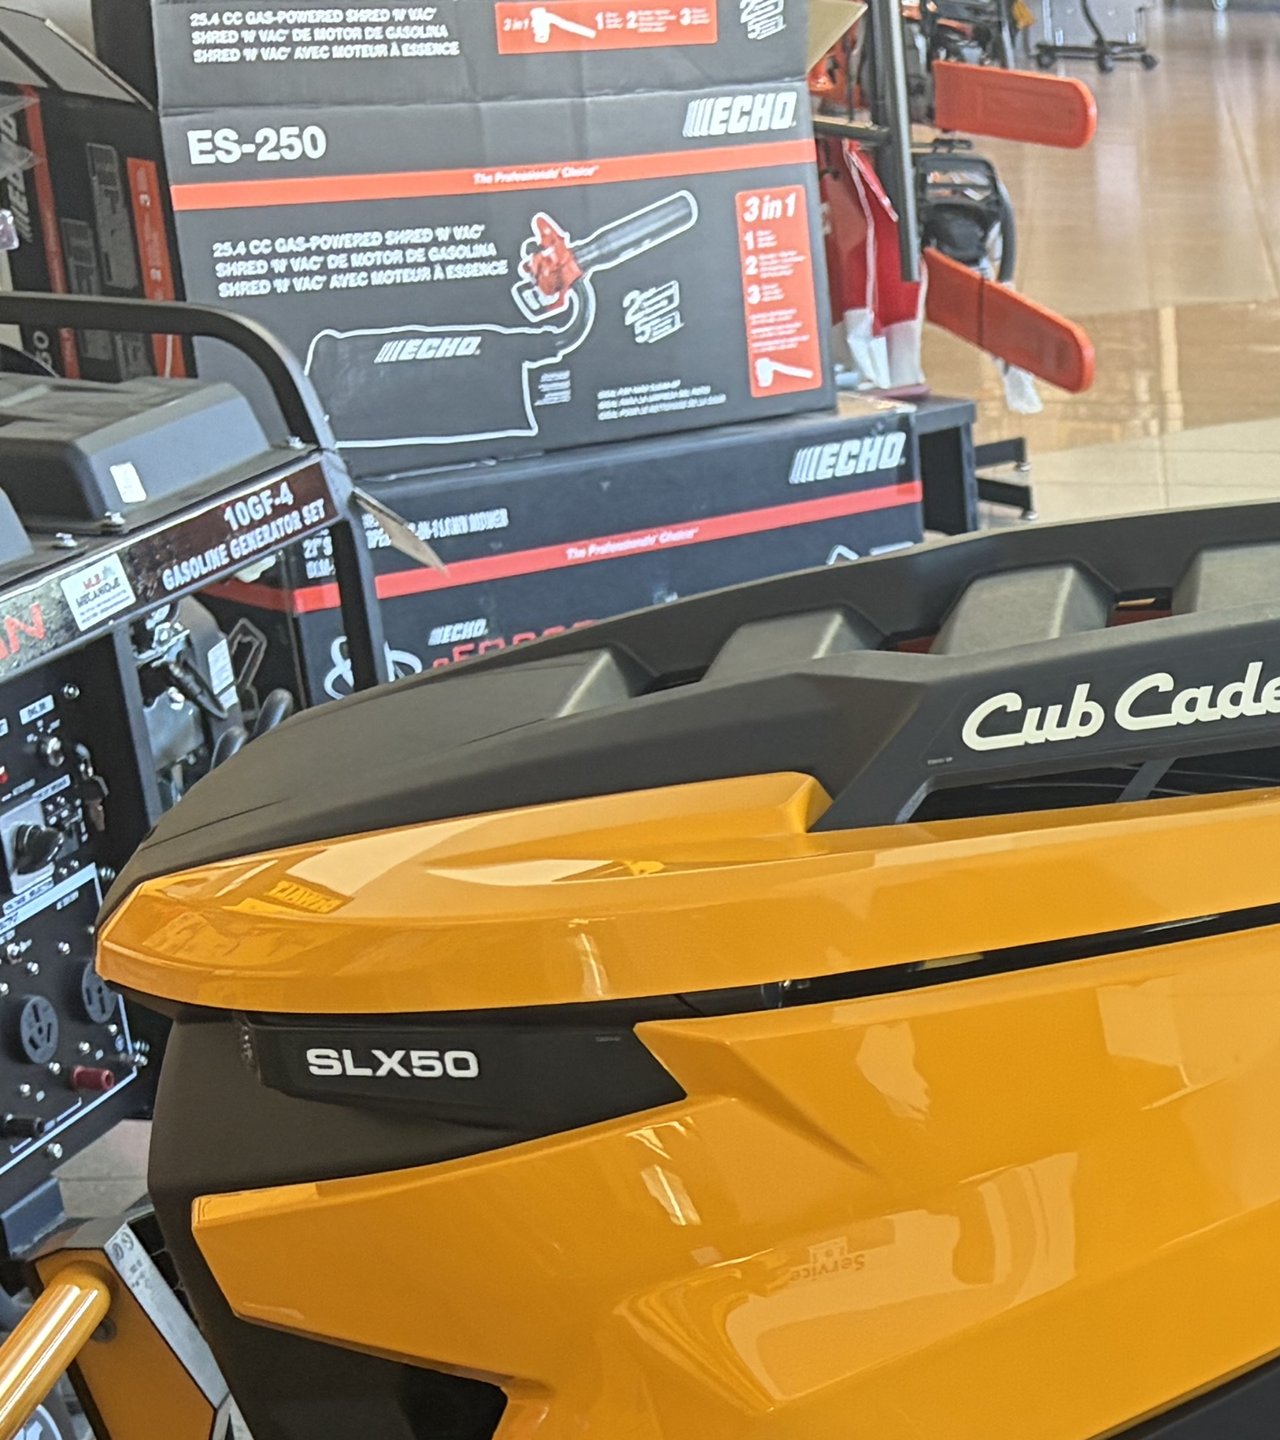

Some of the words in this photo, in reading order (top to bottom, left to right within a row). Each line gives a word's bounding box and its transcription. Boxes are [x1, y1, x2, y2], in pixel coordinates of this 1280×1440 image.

[222, 11, 243, 26] CC
[245, 9, 344, 25] GAS-POWERED
[191, 31, 239, 45] SHRED
[292, 28, 312, 41] DE
[313, 27, 362, 41] MOTOR
[364, 26, 384, 40] DE
[193, 48, 241, 63] SHRED
[294, 45, 330, 60] AVEC
[332, 44, 388, 59] MOTEUR
[402, 41, 460, 57] ESSENCE
[711, 91, 798, 136] ECHO
[187, 125, 327, 165] ES-250
[744, 197, 760, 222] 3
[761, 198, 782, 219] in
[784, 192, 797, 217] 1
[213, 241, 246, 257] 25.4
[250, 240, 272, 255] CC
[275, 231, 382, 254] GAS-POWERED
[385, 228, 433, 247] SHRED
[744, 231, 754, 250] 1
[216, 260, 268, 277] SHRED
[327, 253, 347, 270] DE
[350, 251, 402, 268] MOTOR
[405, 249, 426, 265] DE
[428, 243, 497, 262] GASOLINA
[745, 255, 759, 275] 2
[218, 280, 271, 298] SHRED
[330, 273, 368, 290] AVEC
[370, 269, 430, 287] MOTEUR
[446, 260, 509, 279] ESSENCE
[747, 283, 761, 304] 3
[398, 336, 481, 360] ECHO
[815, 432, 906, 481] ECHO
[224, 481, 294, 531] 10GF-4
[162, 543, 229, 591] GASOLINE
[230, 510, 302, 560] GENERATOR
[303, 498, 326, 527] SET
[961, 683, 1105, 751] Cub
[306, 1048, 480, 1079] SLX50
